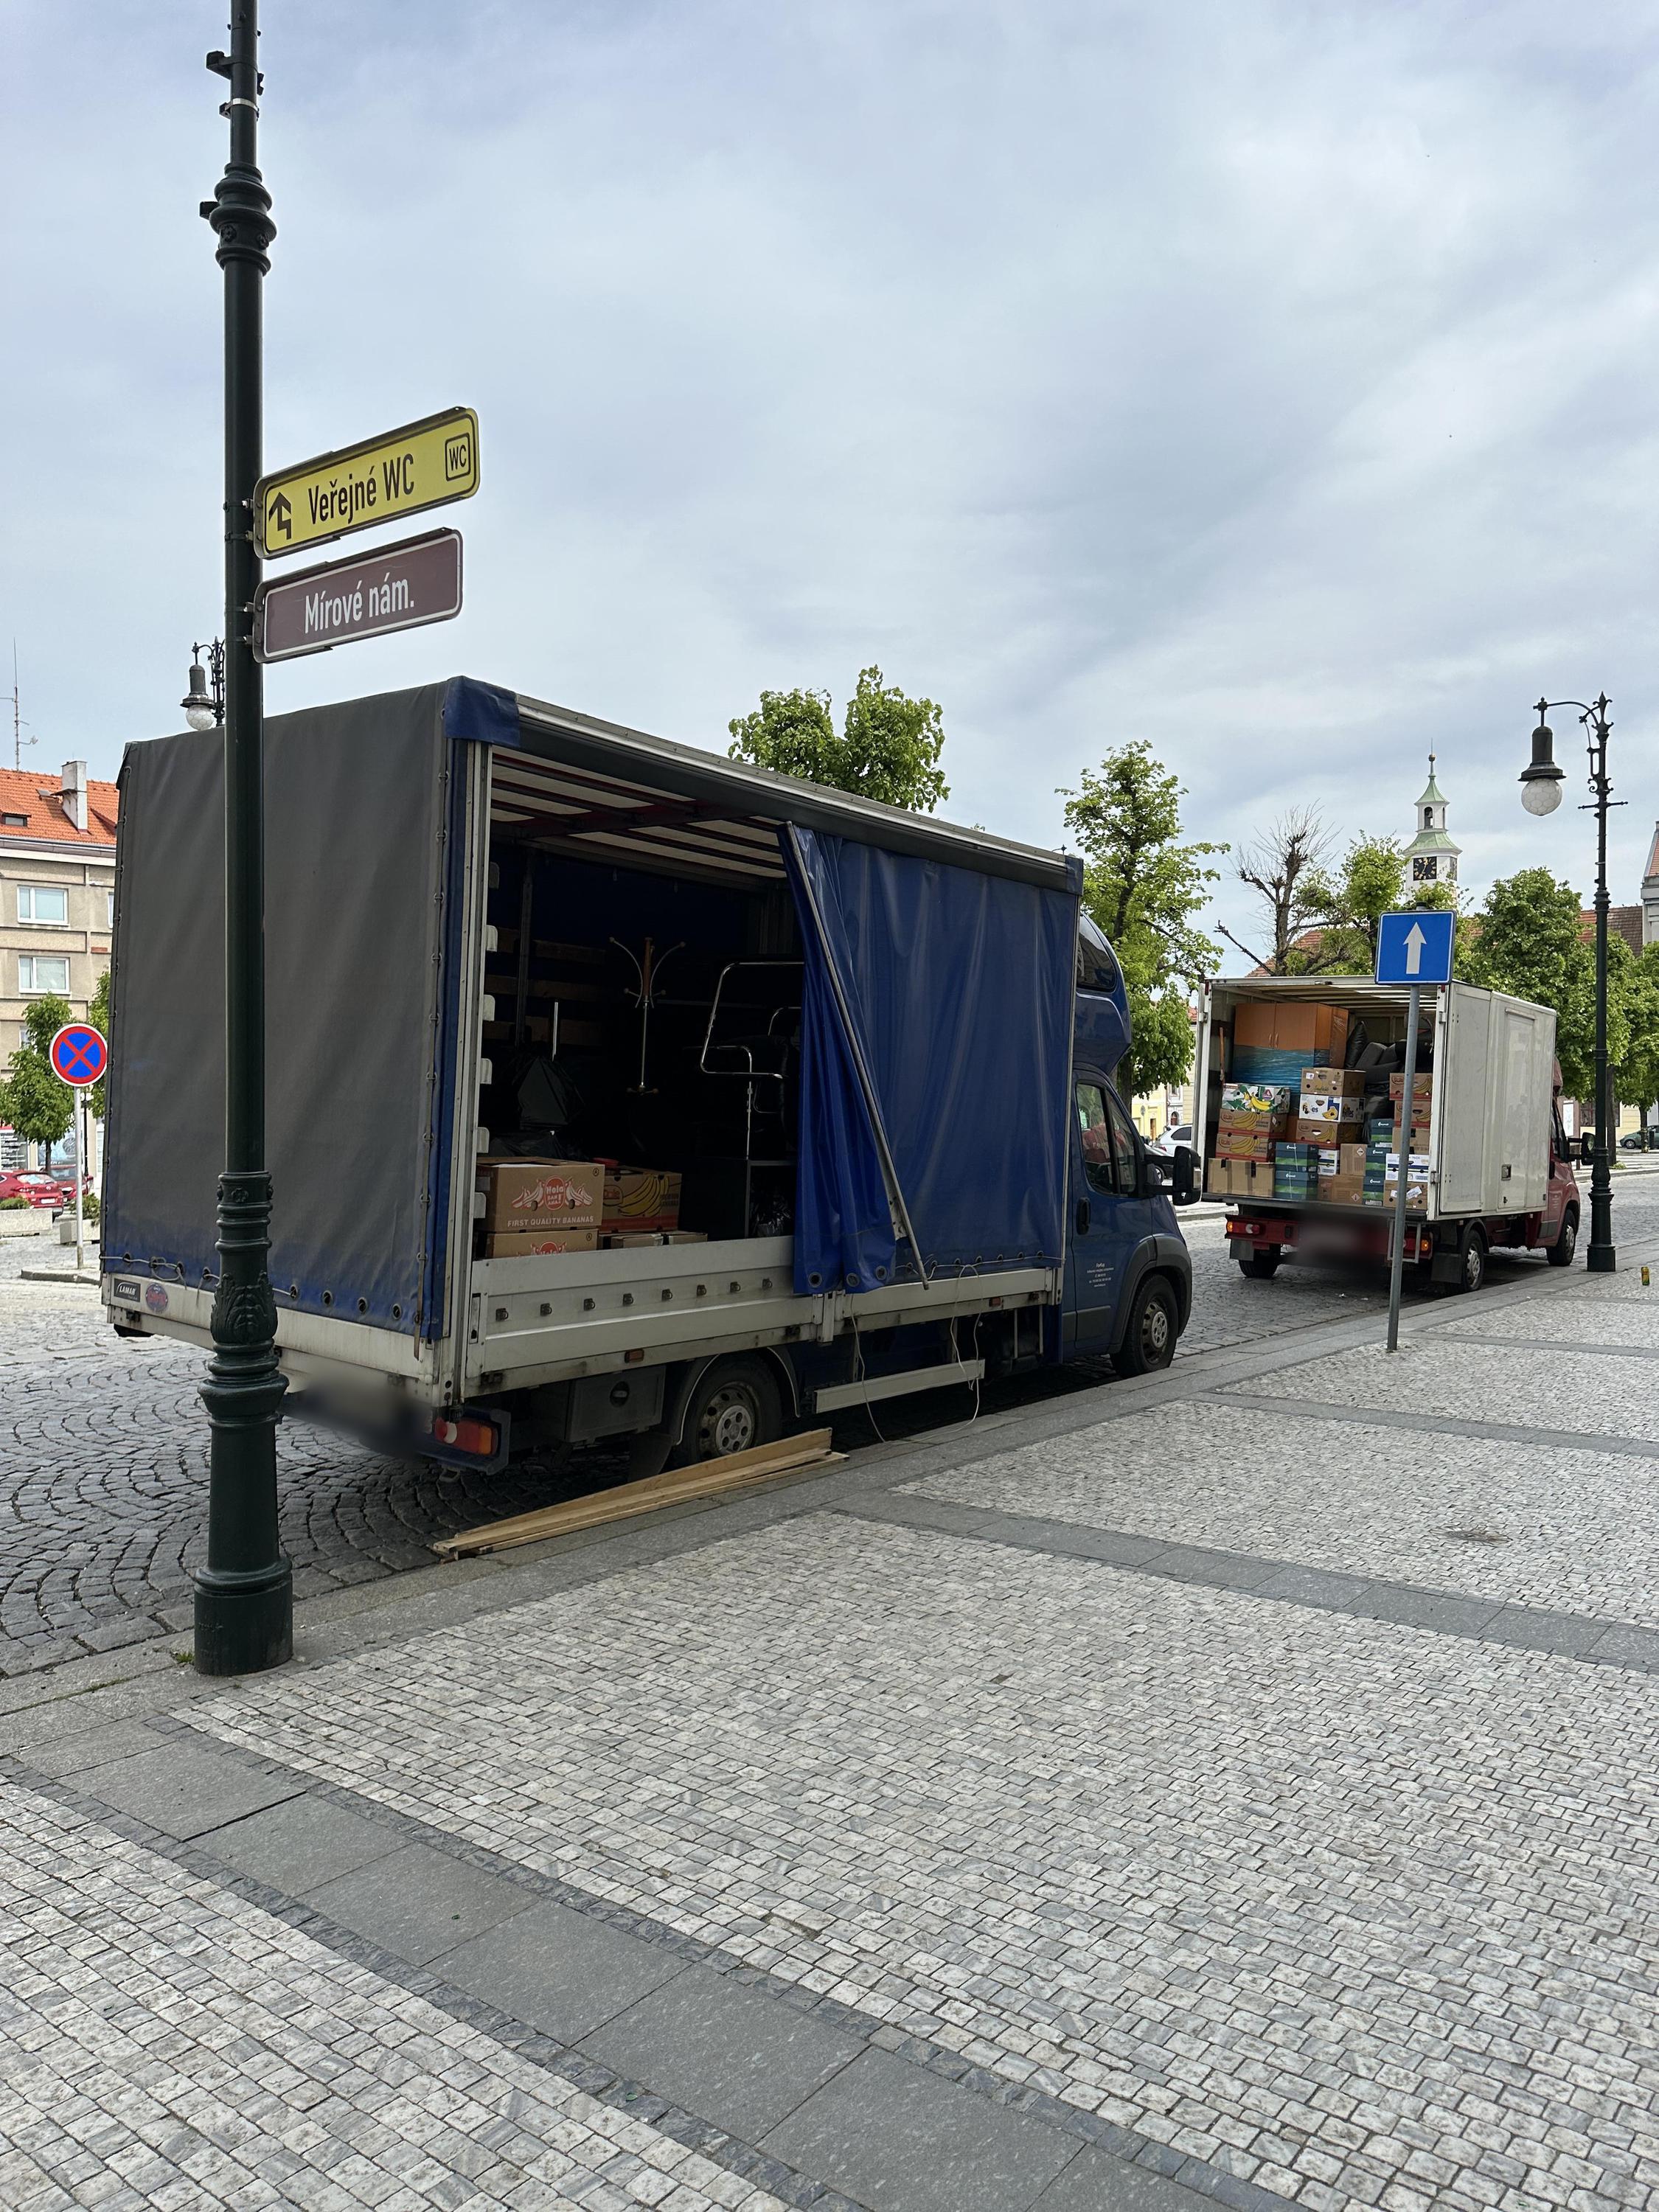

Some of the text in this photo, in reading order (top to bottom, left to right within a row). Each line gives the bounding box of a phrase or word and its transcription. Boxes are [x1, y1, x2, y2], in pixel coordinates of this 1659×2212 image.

[448, 444, 467, 470] WC
[308, 453, 414, 524] Veřejné WC
[305, 573, 414, 633] Mírové nám.
[546, 1185, 564, 1194] Hola
[507, 1216, 594, 1228] FIRST QUALITY BANANAS
